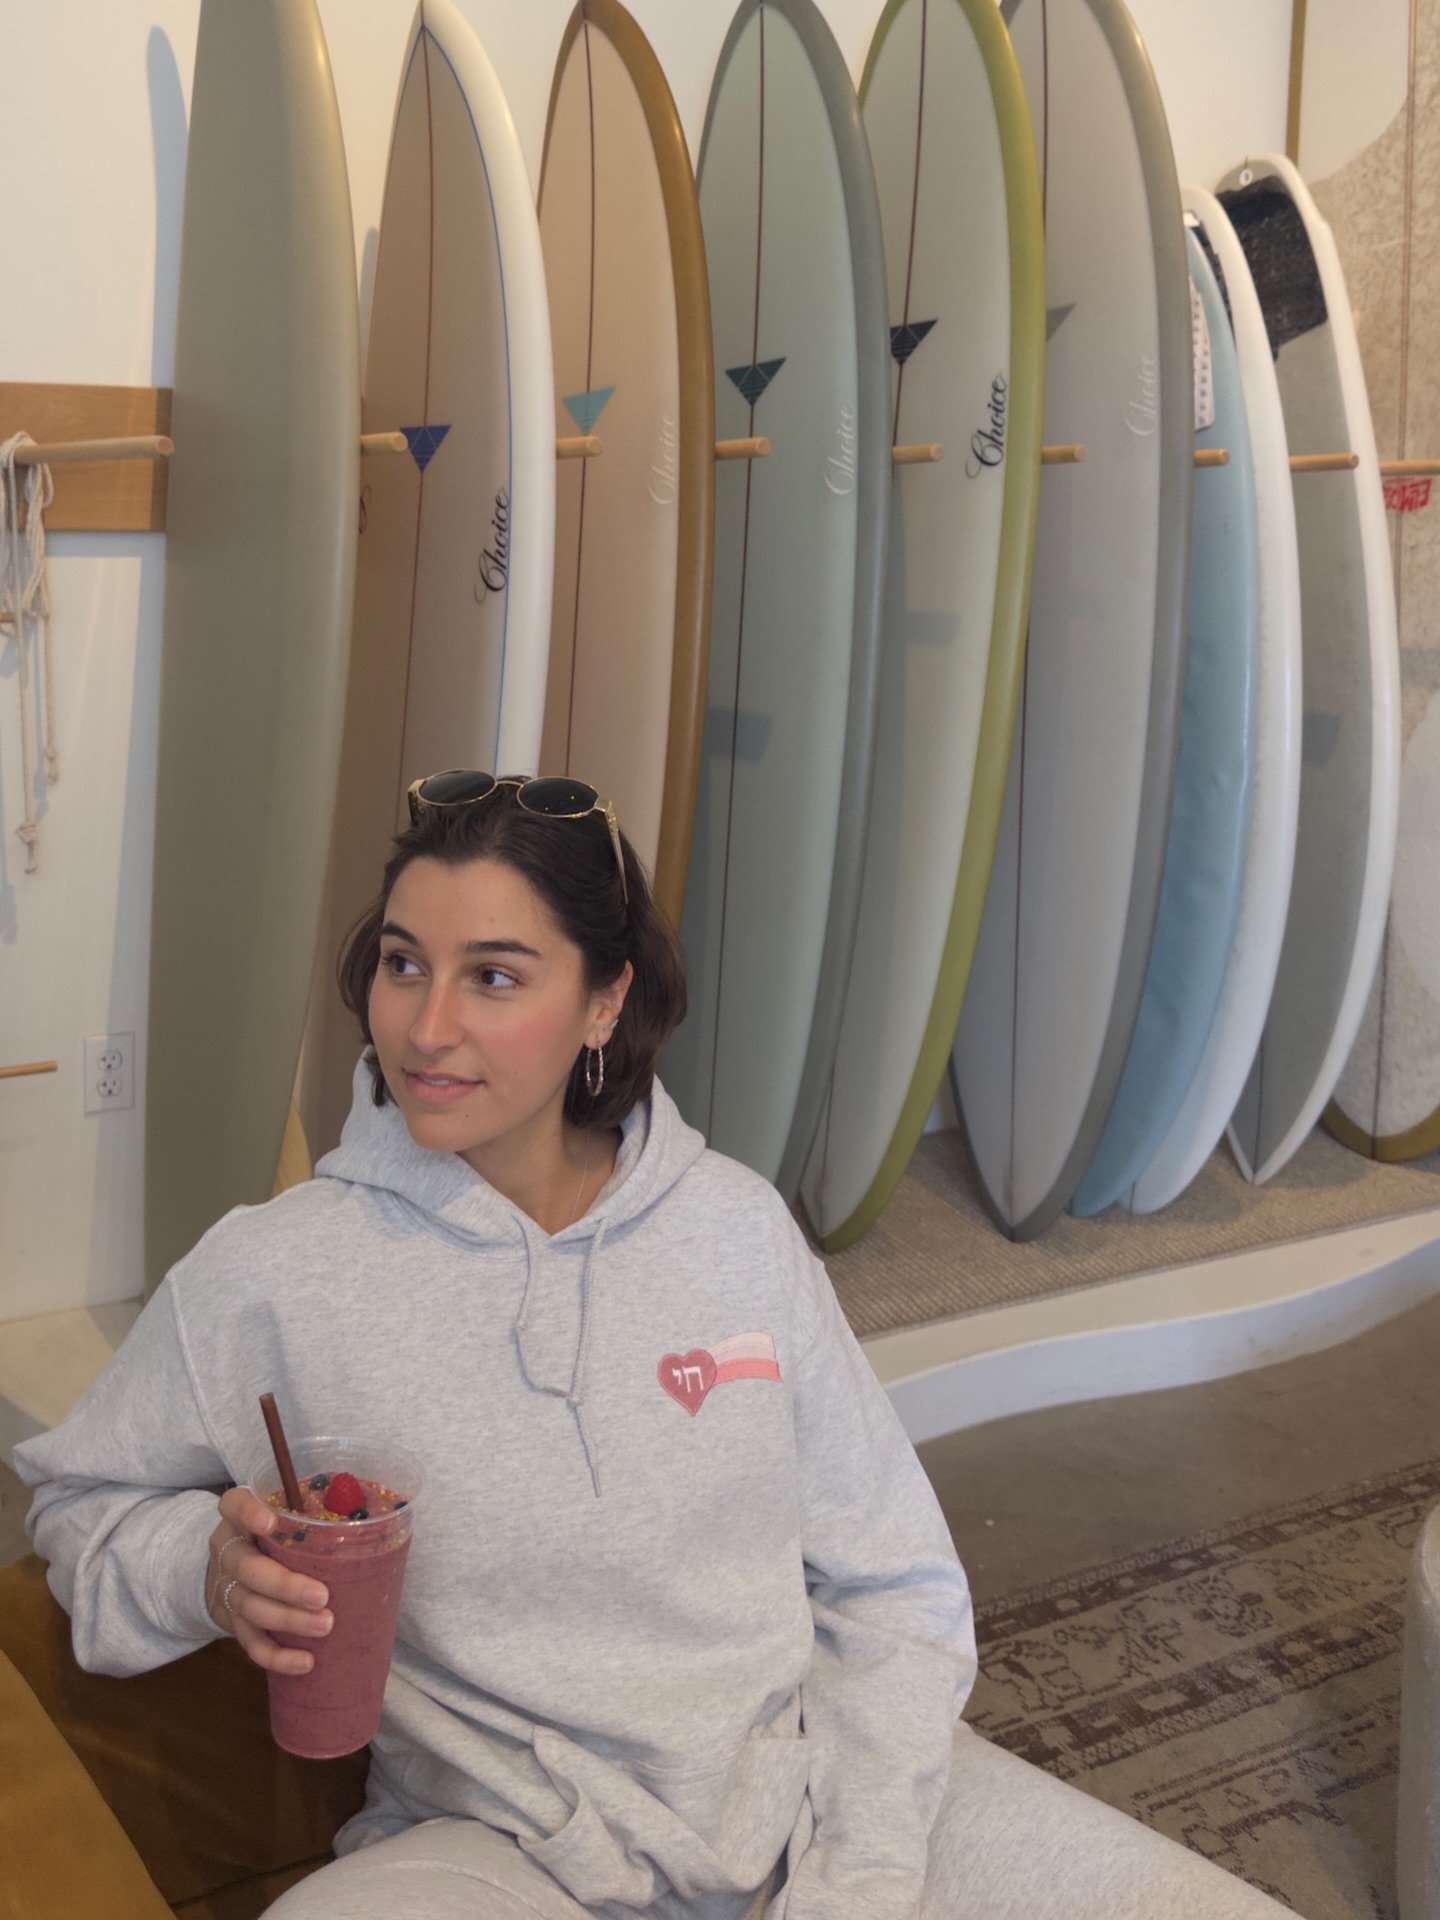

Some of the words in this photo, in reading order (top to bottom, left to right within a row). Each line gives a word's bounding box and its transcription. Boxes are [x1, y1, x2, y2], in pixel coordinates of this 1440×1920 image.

[965, 371, 1007, 479] Choice
[1122, 352, 1157, 437] Choice
[646, 410, 677, 507] Choice
[822, 403, 855, 496] Choice
[474, 486, 508, 604] Choice
[671, 1365, 704, 1393] חי
